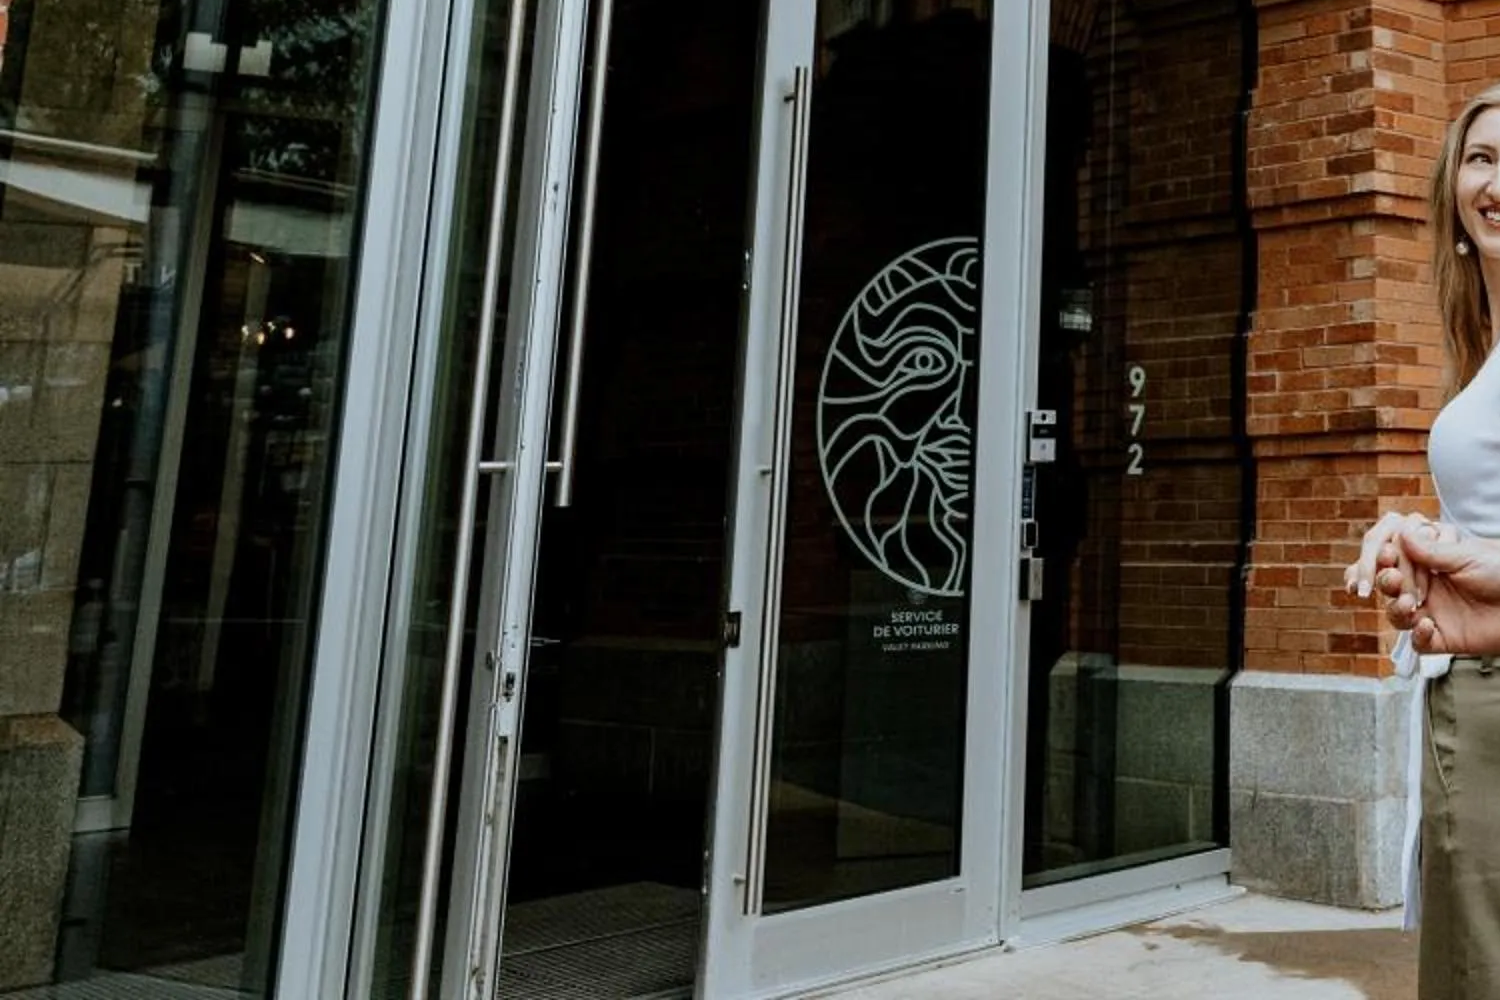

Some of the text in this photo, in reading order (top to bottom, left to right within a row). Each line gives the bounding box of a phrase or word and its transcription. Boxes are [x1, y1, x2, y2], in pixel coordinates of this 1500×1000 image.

[1127, 366, 1146, 475] 972
[891, 610, 943, 623] SERVICE
[873, 623, 959, 638] DE VOITURIER
